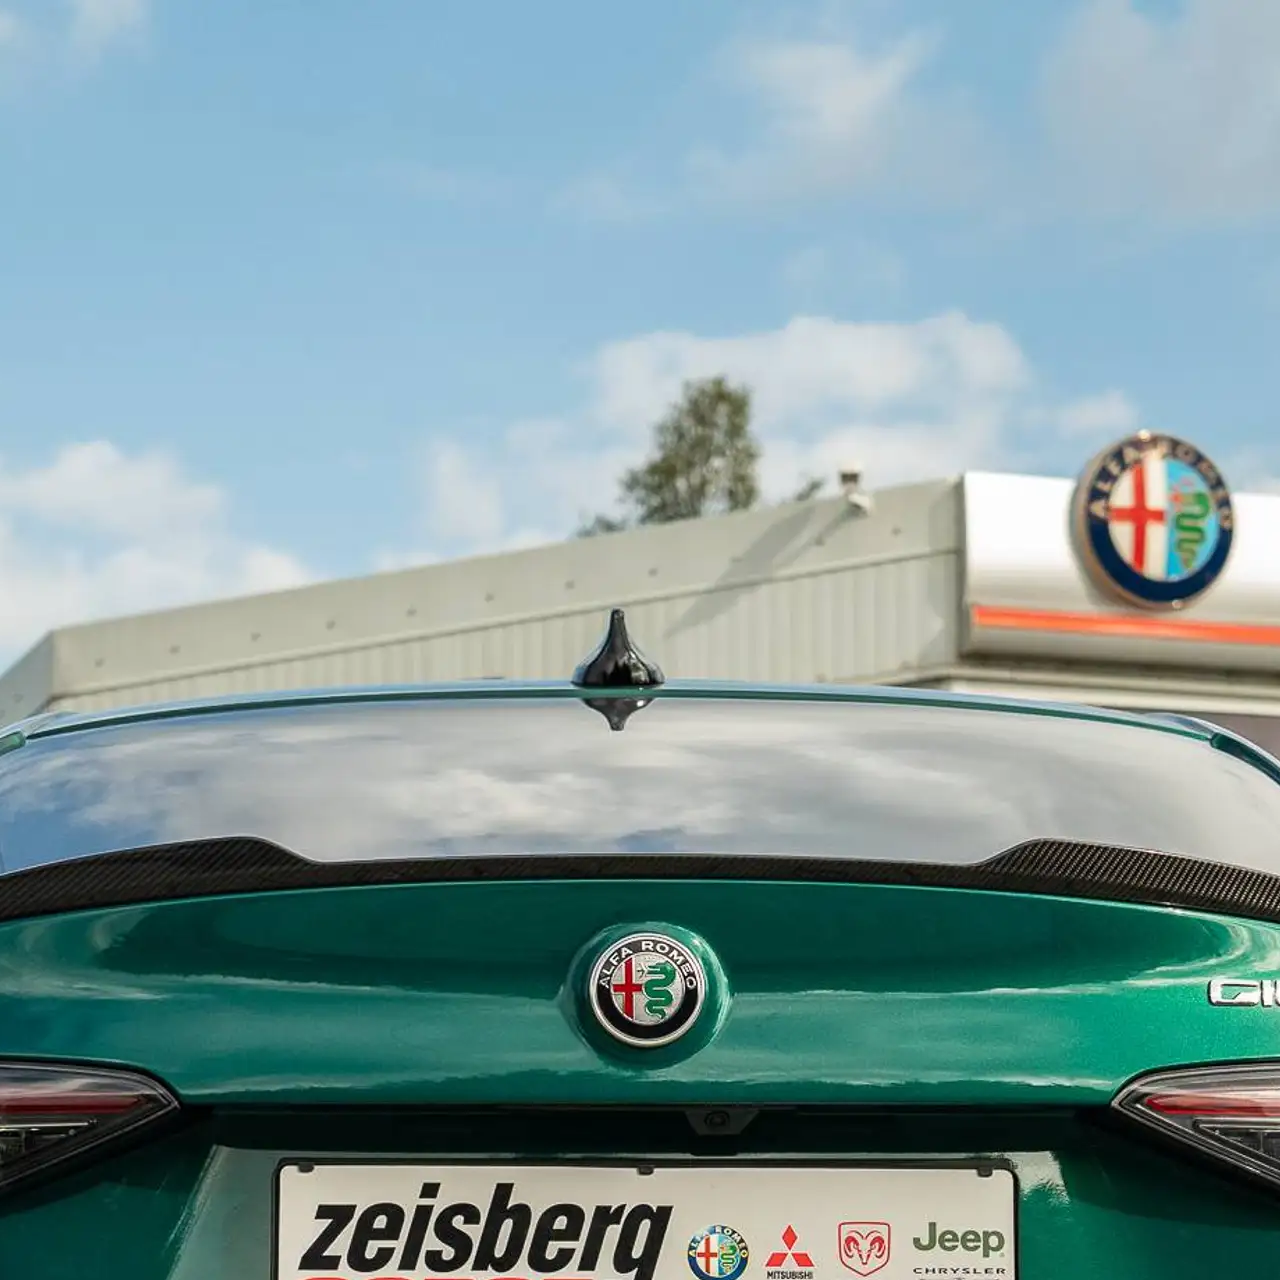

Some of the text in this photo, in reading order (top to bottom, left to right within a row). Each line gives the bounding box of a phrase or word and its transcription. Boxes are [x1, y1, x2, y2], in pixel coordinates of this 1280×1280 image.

[599, 940, 697, 989] ALFA ROMEO
[714, 1225, 750, 1258] ROMEO
[912, 1221, 1006, 1258] Jeep
[766, 1270, 814, 1280] MITSUBISHI
[912, 1267, 1007, 1275] CHRYSLER
